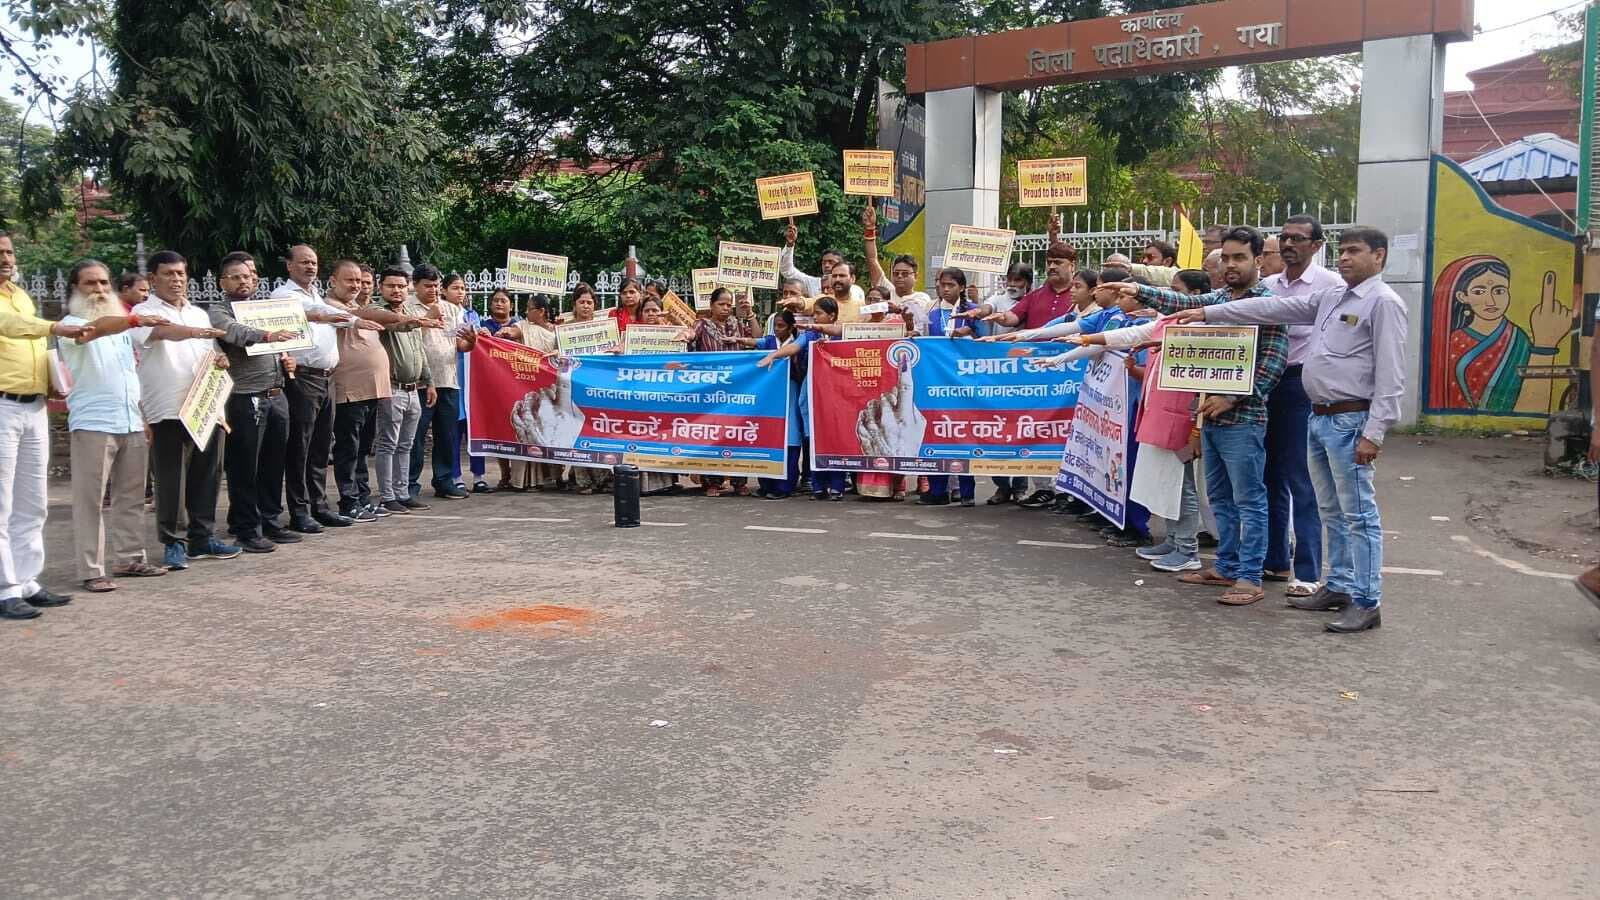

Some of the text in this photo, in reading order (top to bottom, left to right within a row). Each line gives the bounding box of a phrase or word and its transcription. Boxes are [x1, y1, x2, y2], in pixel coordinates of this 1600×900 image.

[1120, 10, 1184, 32] कार्यालय
[1026, 48, 1075, 74] जिला
[1236, 22, 1282, 49] गया
[1031, 173, 1045, 183] Vote
[1046, 172, 1055, 182] for
[768, 188, 780, 198] Vote
[1023, 187, 1041, 198] Proud
[1043, 188, 1049, 197] to
[1051, 187, 1058, 198] be
[1065, 186, 1081, 197] Voter
[764, 201, 779, 210] Proud
[780, 200, 785, 209] to
[787, 199, 793, 208] be
[798, 197, 812, 207] Voter
[518, 262, 530, 272] Vote
[532, 263, 540, 273] for
[511, 273, 527, 284] Proud
[528, 275, 534, 285] to
[535, 276, 542, 287] be
[548, 278, 562, 289] Voter
[1168, 344, 1184, 359] देश
[1186, 344, 1197, 359] के
[1198, 347, 1235, 361] मतदाता
[956, 358, 1019, 376] प्रभात
[1169, 363, 1186, 378] वोट
[1188, 364, 1207, 379] देना
[1209, 367, 1234, 380] आता
[515, 373, 536, 382] 2025
[617, 367, 675, 383] प्रभात
[677, 368, 733, 384] खबर
[857, 380, 878, 388] 2025
[928, 384, 975, 398] मतदाता
[977, 384, 1048, 398] जागरूकता
[585, 387, 756, 405] मतदाता जागरूकता अभियान
[591, 412, 759, 445] वोट करें, बिहार गढ़ें
[932, 414, 1072, 442] वोट करें, बिहार
